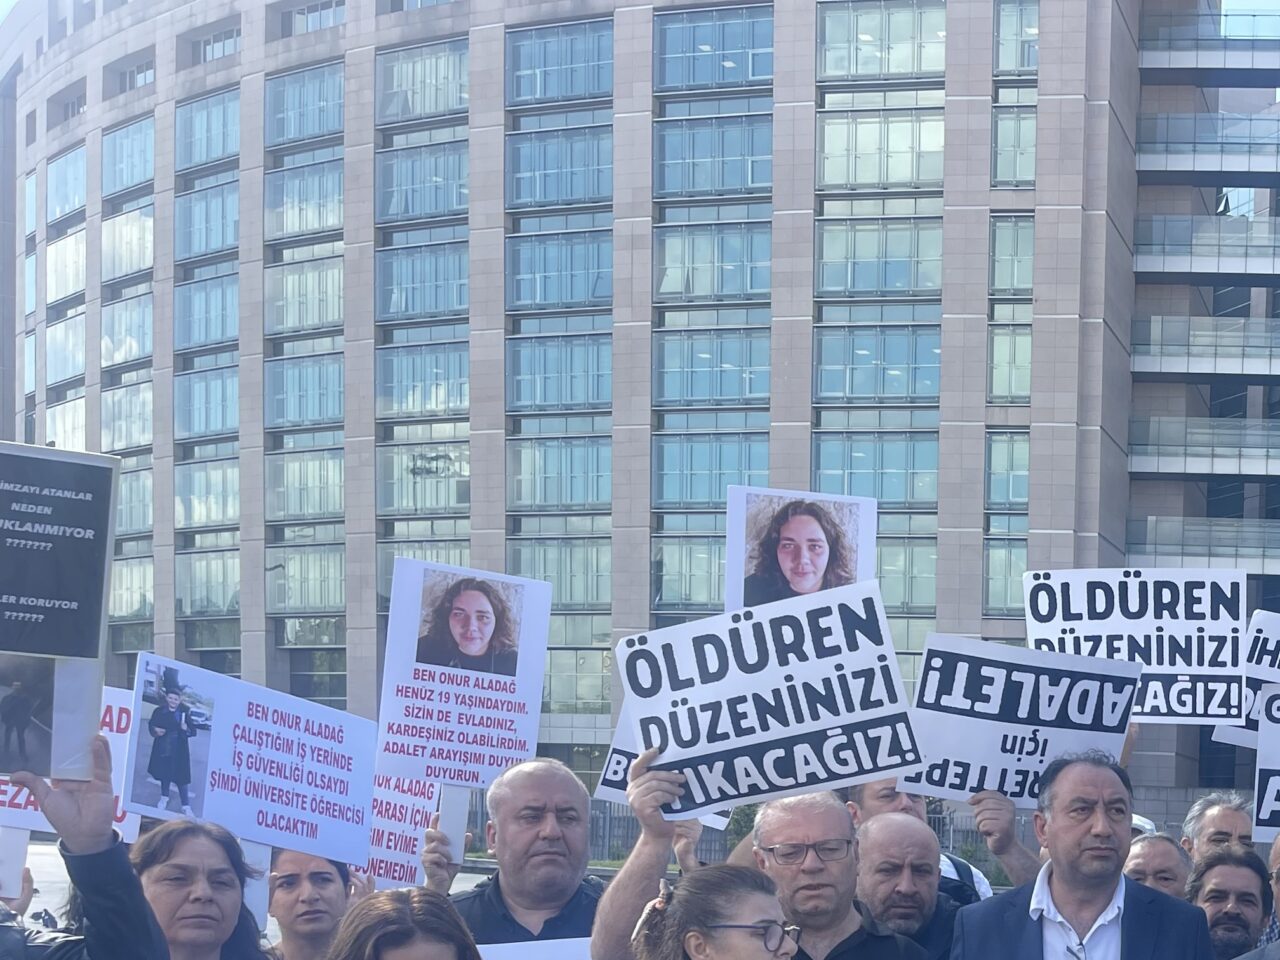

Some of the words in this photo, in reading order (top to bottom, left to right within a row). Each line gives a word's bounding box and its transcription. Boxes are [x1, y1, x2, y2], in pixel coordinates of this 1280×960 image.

[11, 503, 52, 515] NEDEN
[42, 487, 92, 500] ATANLAR
[19, 597, 78, 609] KORUYOR
[1030, 570, 1240, 623] ÖLDÜREN
[625, 597, 884, 698] ÖLDÜREN
[413, 668, 435, 682] BEN
[439, 673, 470, 688] ONUR
[474, 677, 516, 694] ALADAĞ
[923, 657, 1133, 728] ADALET!
[1132, 676, 1239, 715] AĞIZ!
[396, 685, 434, 701] HENÜZ
[438, 691, 450, 703] 19
[454, 693, 528, 714] YAŞINDAYDIM.
[640, 654, 898, 753] DÜZENİNİZİ
[247, 702, 269, 722] BEN
[272, 709, 301, 731] ONUR
[304, 719, 344, 744] ALADAĞ
[404, 705, 433, 720] SİZİN
[437, 709, 451, 722] DE
[458, 713, 517, 733] EVLADINIZ,
[233, 724, 294, 755] ÇALIŞTIĞIM
[297, 738, 307, 762] İŞ
[310, 745, 352, 772] YERİNDE
[384, 742, 427, 757] ADALET
[430, 747, 485, 765] ARAYIŞIMI
[387, 722, 454, 742] KARDEŞİNİZ
[458, 732, 529, 752] OLABİLİRDİM.
[1000, 729, 1048, 764] için
[232, 746, 243, 771] İŞ
[247, 752, 304, 784] GÜVENLİĞİ
[307, 771, 348, 796] OLSAYDI
[426, 766, 479, 783] DUYURUN
[671, 722, 914, 809] IKACAĞIZ!
[210, 768, 241, 794] ŞİMDİ
[245, 776, 307, 811] ÜNİVERSİTE
[311, 794, 364, 825] ÖĞRENCİSİ
[257, 810, 318, 839] OLACAKTIM
[372, 798, 408, 823] PARASI
[410, 804, 432, 831] İÇİN
[386, 831, 418, 855] EVİME
